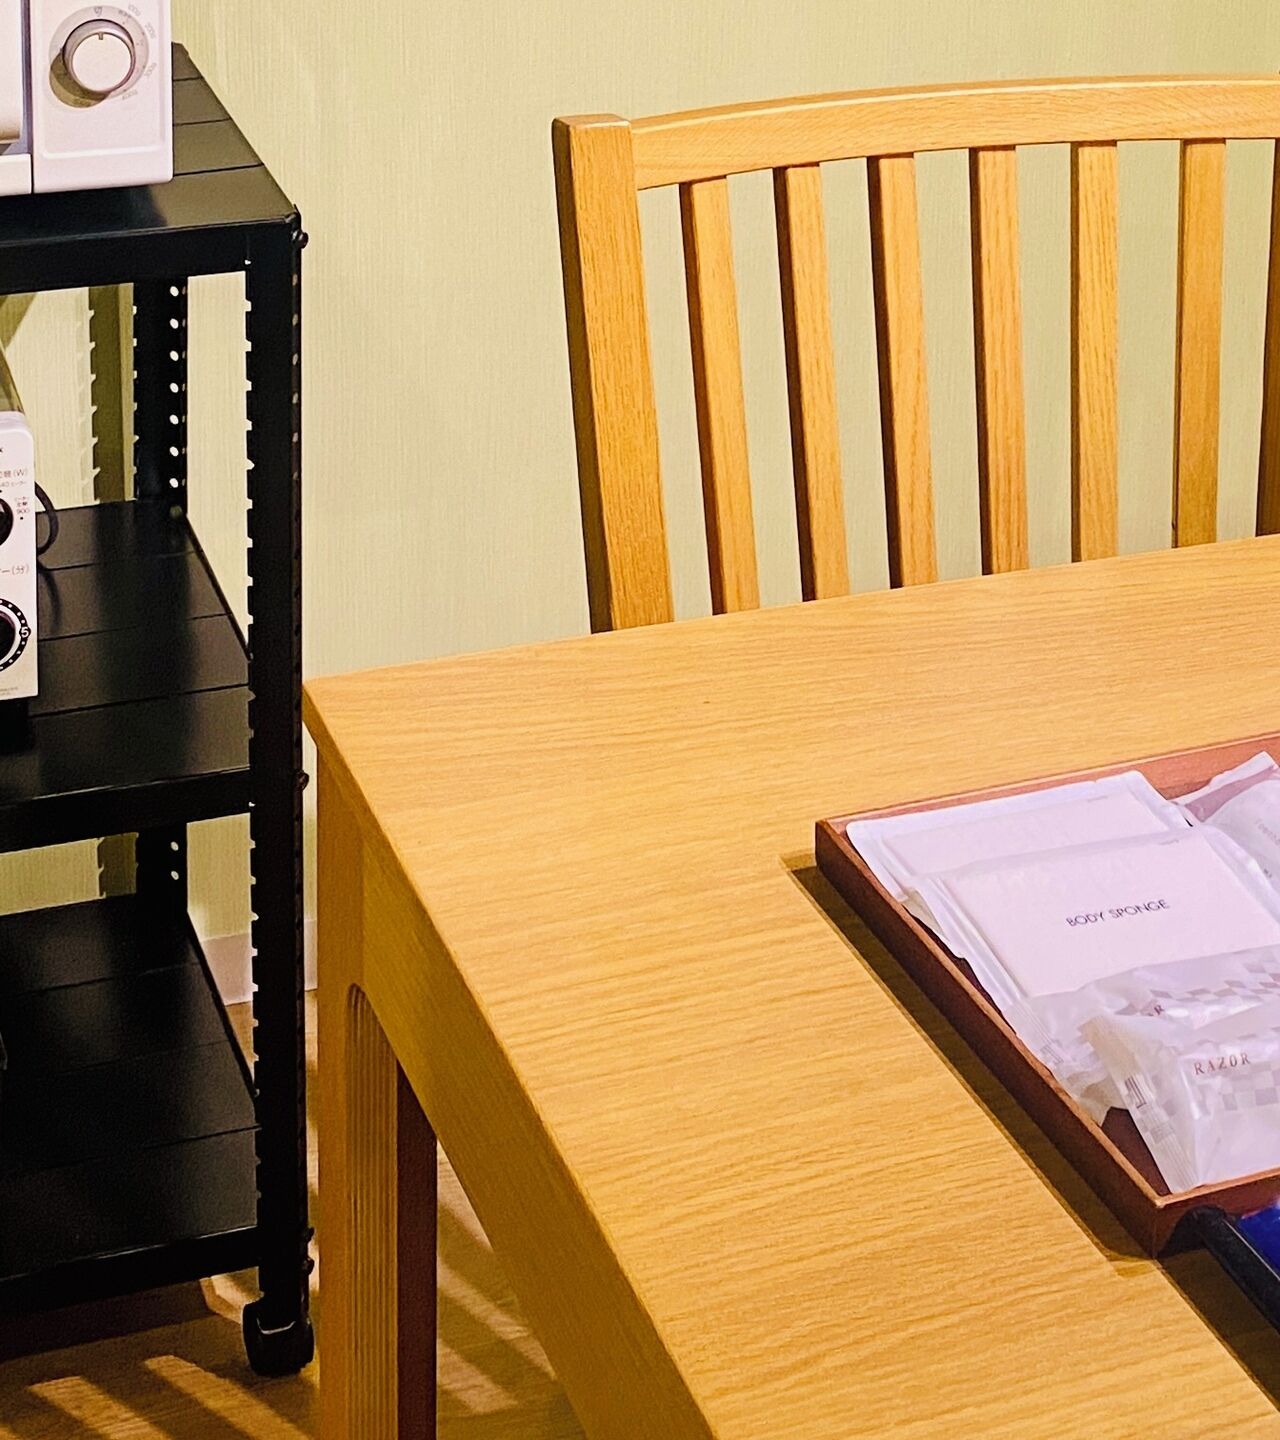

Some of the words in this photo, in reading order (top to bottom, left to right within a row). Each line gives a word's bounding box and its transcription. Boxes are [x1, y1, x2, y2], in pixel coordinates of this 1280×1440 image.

[21, 628, 29, 638] 5
[1066, 912, 1105, 927] BODY
[1108, 899, 1171, 919] SPONGE
[1194, 1053, 1251, 1075] RAZOR
